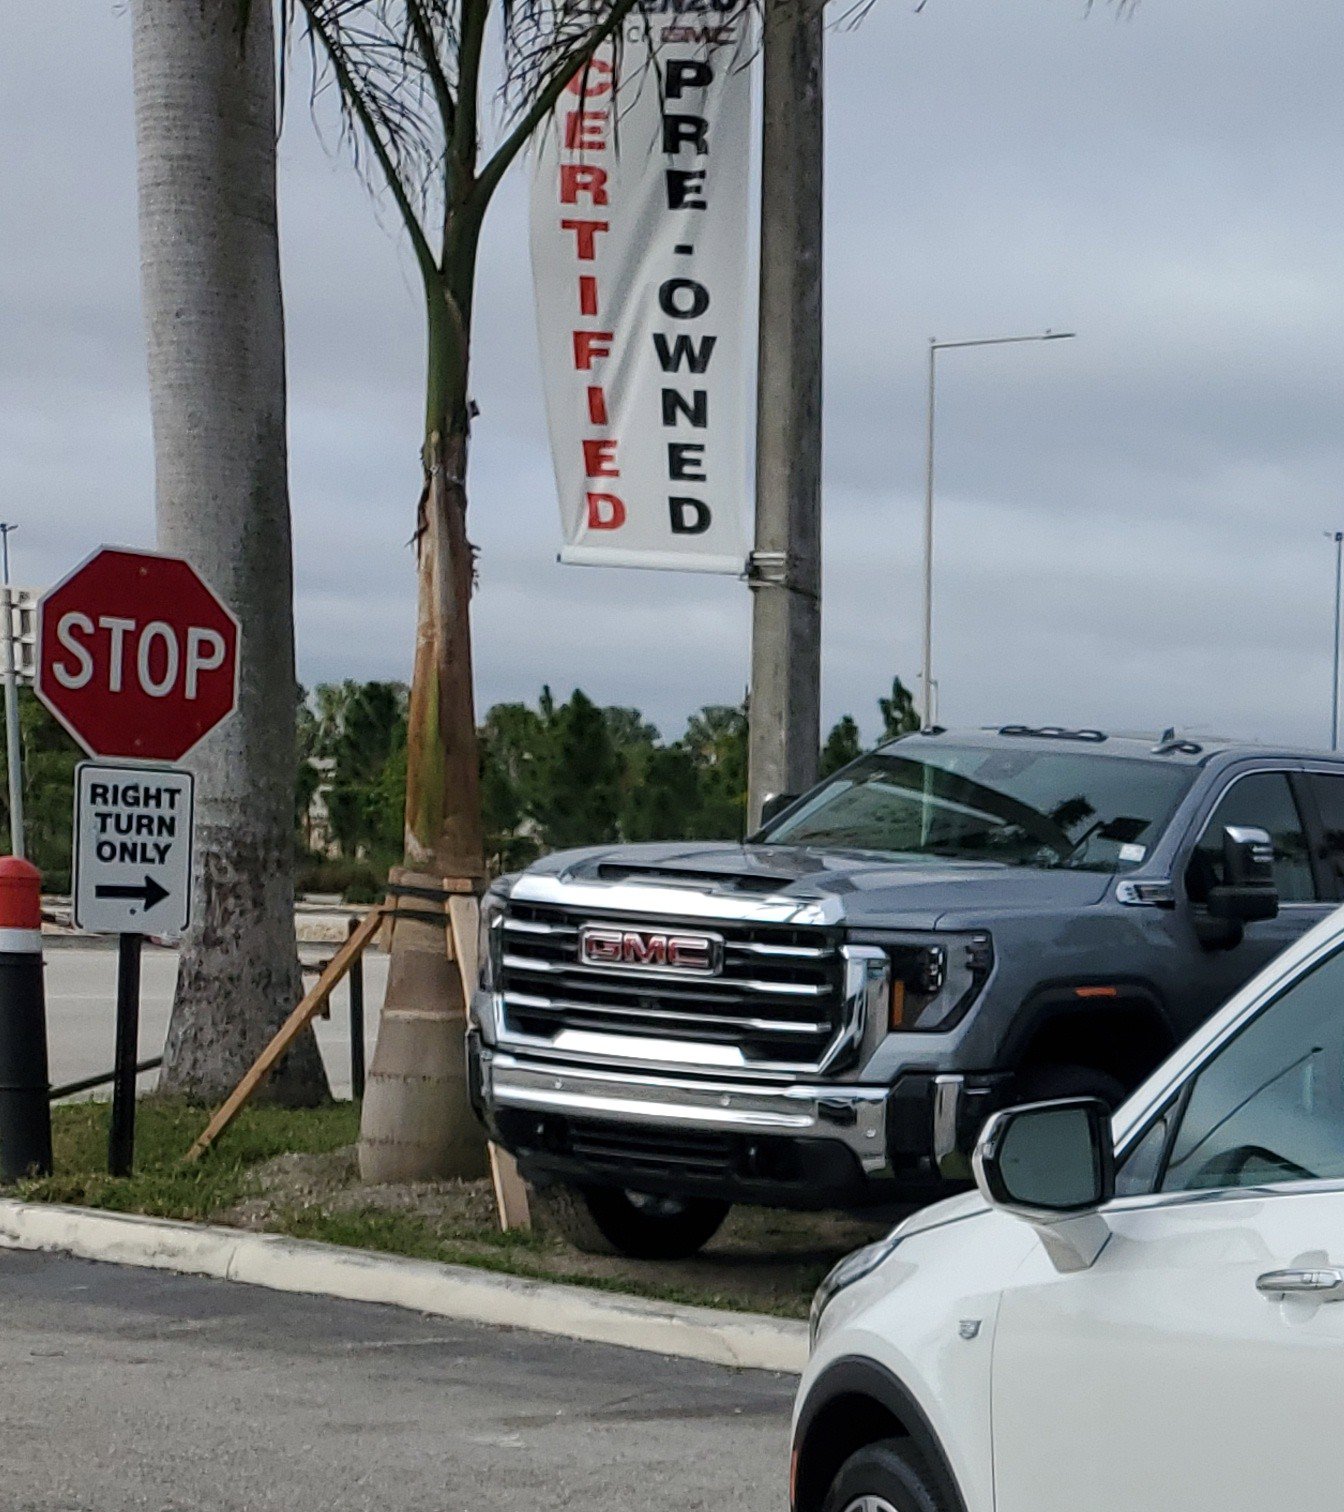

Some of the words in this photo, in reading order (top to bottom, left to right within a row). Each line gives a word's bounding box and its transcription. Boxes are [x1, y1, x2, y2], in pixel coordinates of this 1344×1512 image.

[560, 57, 627, 531] CERTIFIED
[653, 59, 718, 535] PRE-OWNED
[52, 611, 227, 701] STOP
[90, 783, 182, 810] RIGHT
[95, 811, 176, 838] TURN
[96, 840, 173, 865] ONLY
[583, 930, 709, 969] GMC
